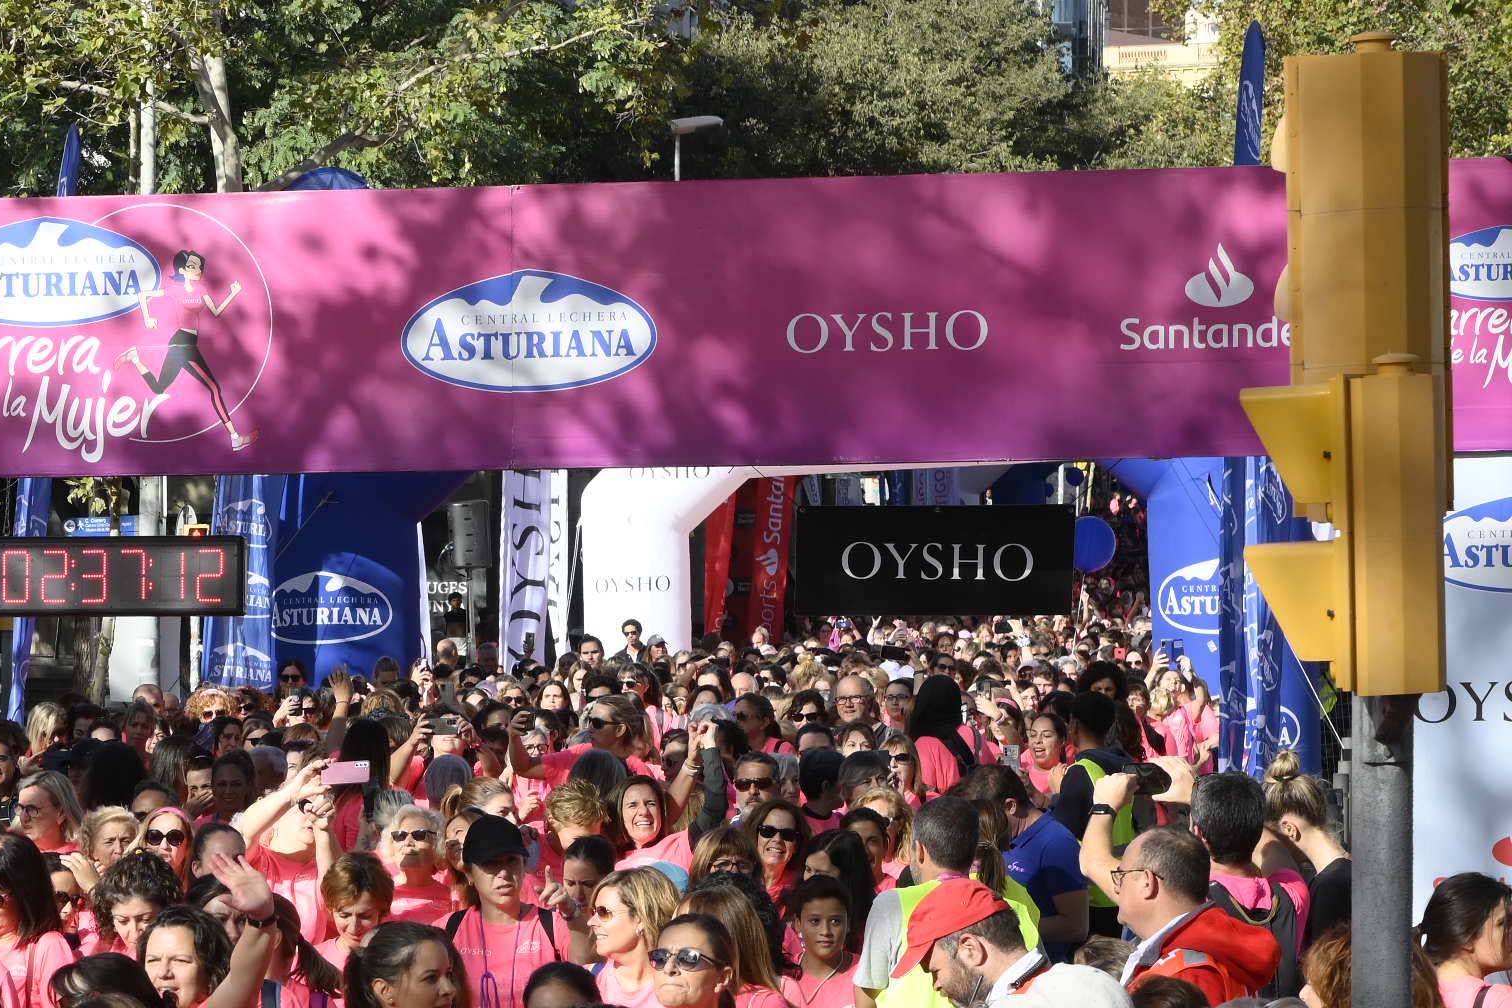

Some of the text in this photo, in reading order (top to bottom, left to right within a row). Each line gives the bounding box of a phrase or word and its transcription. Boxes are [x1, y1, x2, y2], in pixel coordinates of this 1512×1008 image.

[64, 253, 136, 265] LECHERA
[1450, 263, 1512, 282] STUR
[460, 310, 628, 325] CENTRAL LECHERA
[786, 309, 988, 354] OYSHO
[421, 316, 638, 362] ASTURIANA
[1120, 316, 1291, 351] Santande
[1469, 336, 1488, 364] la
[2, 376, 27, 418] la
[22, 368, 171, 463] Mujer
[763, 476, 785, 545] Santa
[1467, 529, 1512, 540] CENT
[2, 548, 224, 604] 02:37:12
[507, 470, 547, 661] OYSH
[841, 540, 1035, 582] OYSHO
[594, 575, 672, 594] OYSHO
[1181, 584, 1220, 594] CENTR
[272, 604, 384, 628] ASTURIANA
